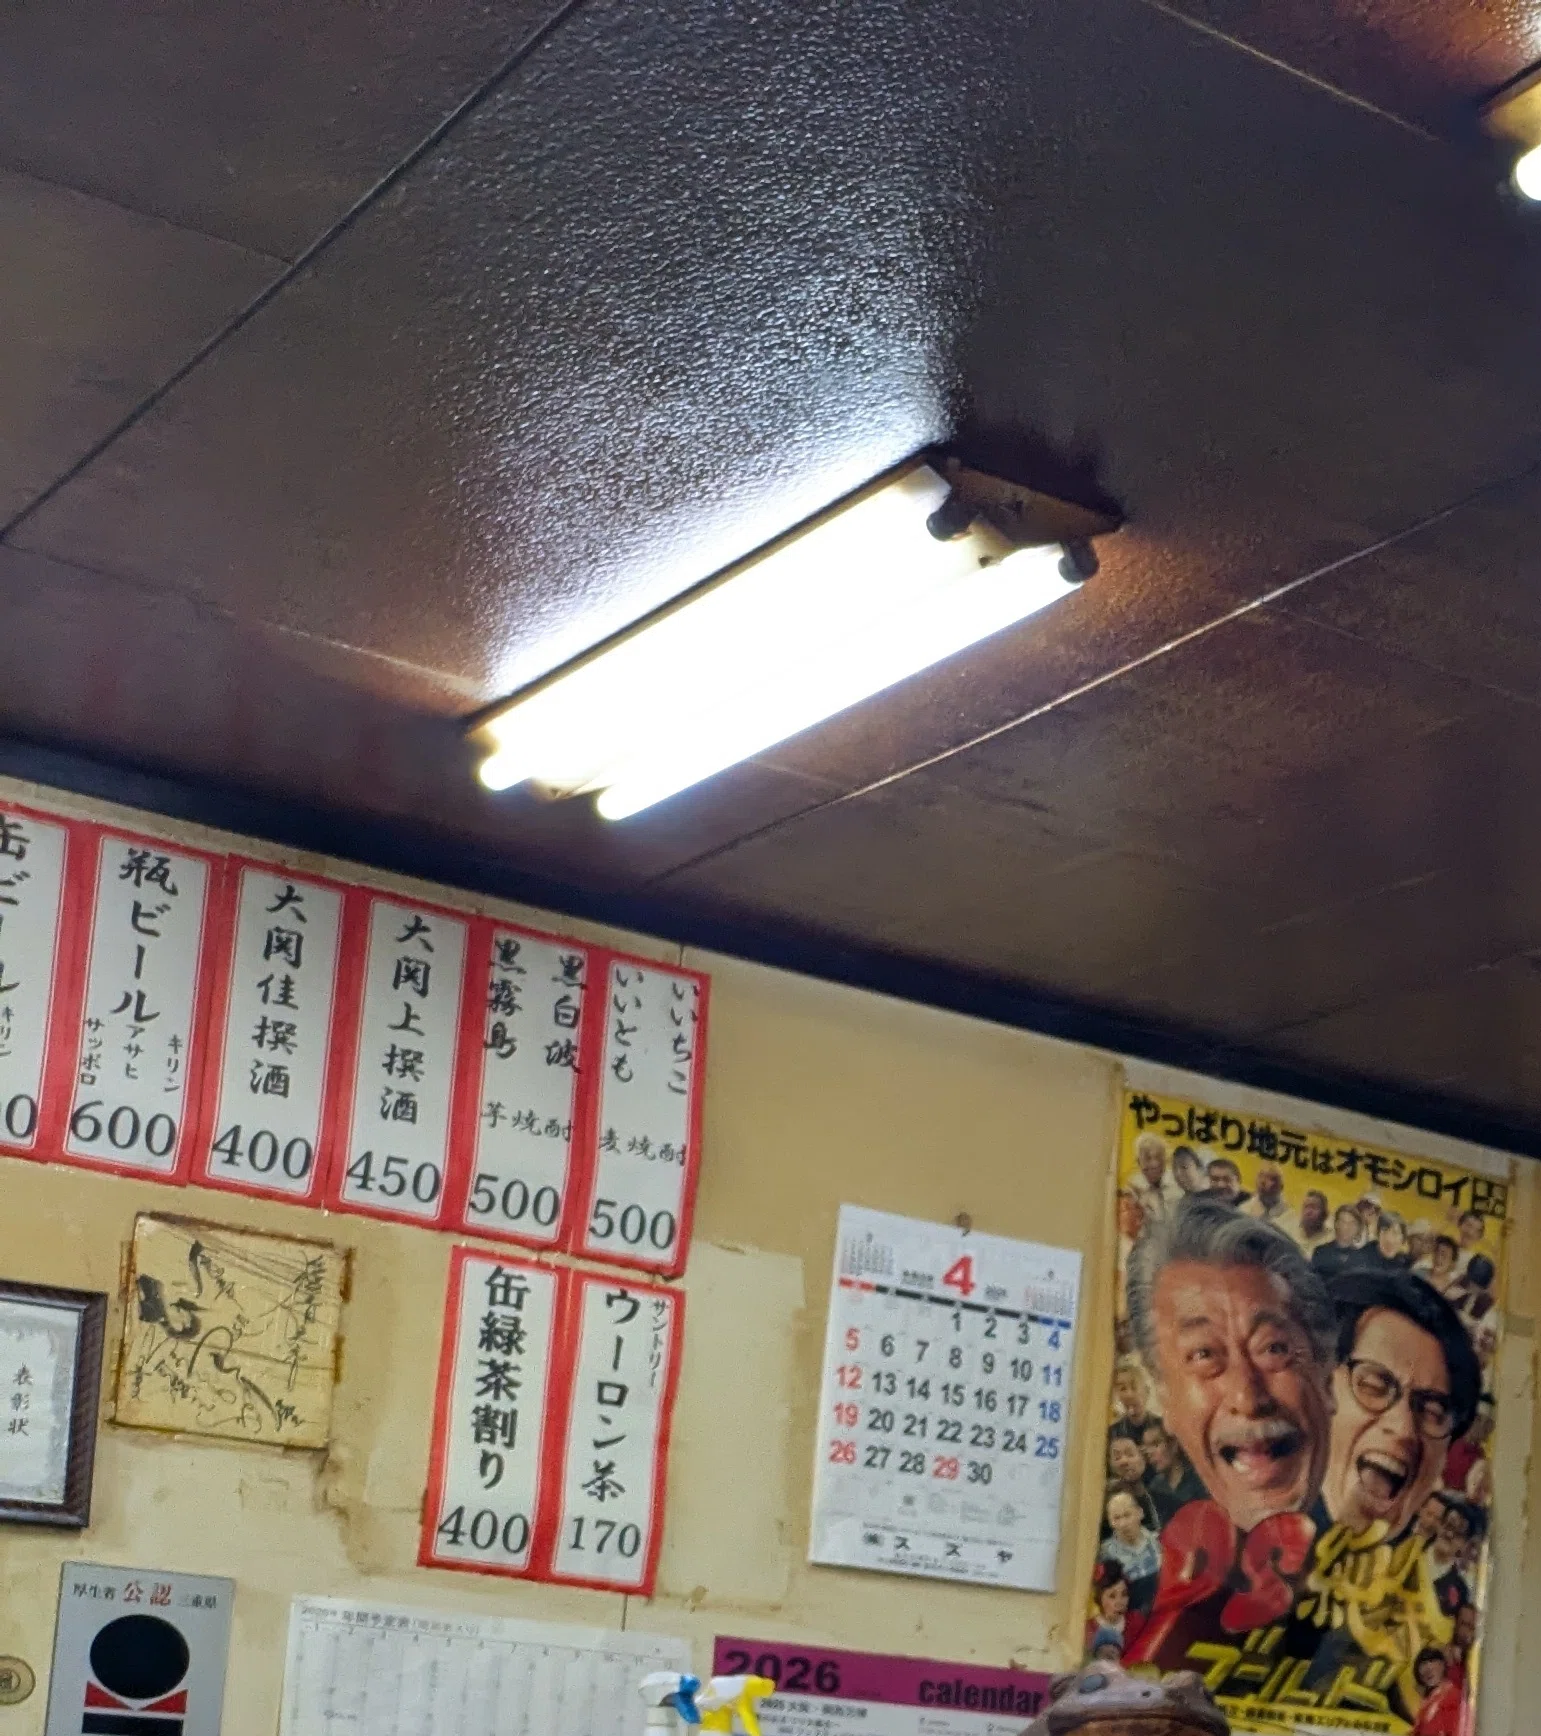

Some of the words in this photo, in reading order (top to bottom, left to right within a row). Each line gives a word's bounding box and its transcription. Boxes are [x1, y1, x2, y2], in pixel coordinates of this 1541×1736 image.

[110, 849, 178, 1023] 瓶ビール
[78, 1017, 104, 1085] サッポロ
[122, 1025, 145, 1080] アサヒ
[611, 967, 644, 1083] いいとも
[668, 982, 699, 1095] いいちこ
[164, 1034, 183, 1093] キリン
[70, 1101, 176, 1156] 600
[212, 1124, 313, 1180] 400
[346, 1150, 440, 1203] 450
[468, 1173, 559, 1225] 500
[588, 1199, 676, 1250] 500
[942, 1254, 976, 1296] 4
[845, 1328, 859, 1351] 5
[881, 1335, 894, 1357] 6
[917, 1341, 929, 1362] 7
[949, 1347, 962, 1368] 8
[982, 1353, 995, 1374] 9
[1011, 1358, 1032, 1382] 10
[1043, 1364, 1062, 1386] 11
[952, 1313, 961, 1331] 1
[985, 1318, 996, 1339] 2
[1018, 1322, 1029, 1345] 3
[1048, 1331, 1061, 1350] 4
[470, 1265, 530, 1490] 缶緑茶割り
[581, 1288, 641, 1502] ウーロン茶
[837, 1366, 861, 1389] 12
[872, 1372, 896, 1395] 13
[906, 1378, 930, 1400] 14
[942, 1384, 965, 1406] 15
[974, 1389, 997, 1412] 16
[1007, 1395, 1030, 1417] 17
[1040, 1400, 1061, 1423] 18
[834, 1403, 858, 1427] 19
[868, 1408, 894, 1432] 20
[904, 1415, 928, 1438] 21
[937, 1420, 962, 1443] 22
[970, 1426, 995, 1448] 23
[1002, 1431, 1027, 1453] 24
[1036, 1435, 1058, 1458] 25
[829, 1440, 856, 1465] 26
[864, 1445, 890, 1468] 27
[900, 1451, 925, 1474] 28
[933, 1457, 959, 1480] 29
[967, 1461, 992, 1484] 30
[438, 1504, 529, 1554] 400
[570, 1516, 641, 1557] 170
[723, 1649, 841, 1693] 2026
[918, 1679, 1044, 1715] calendar
